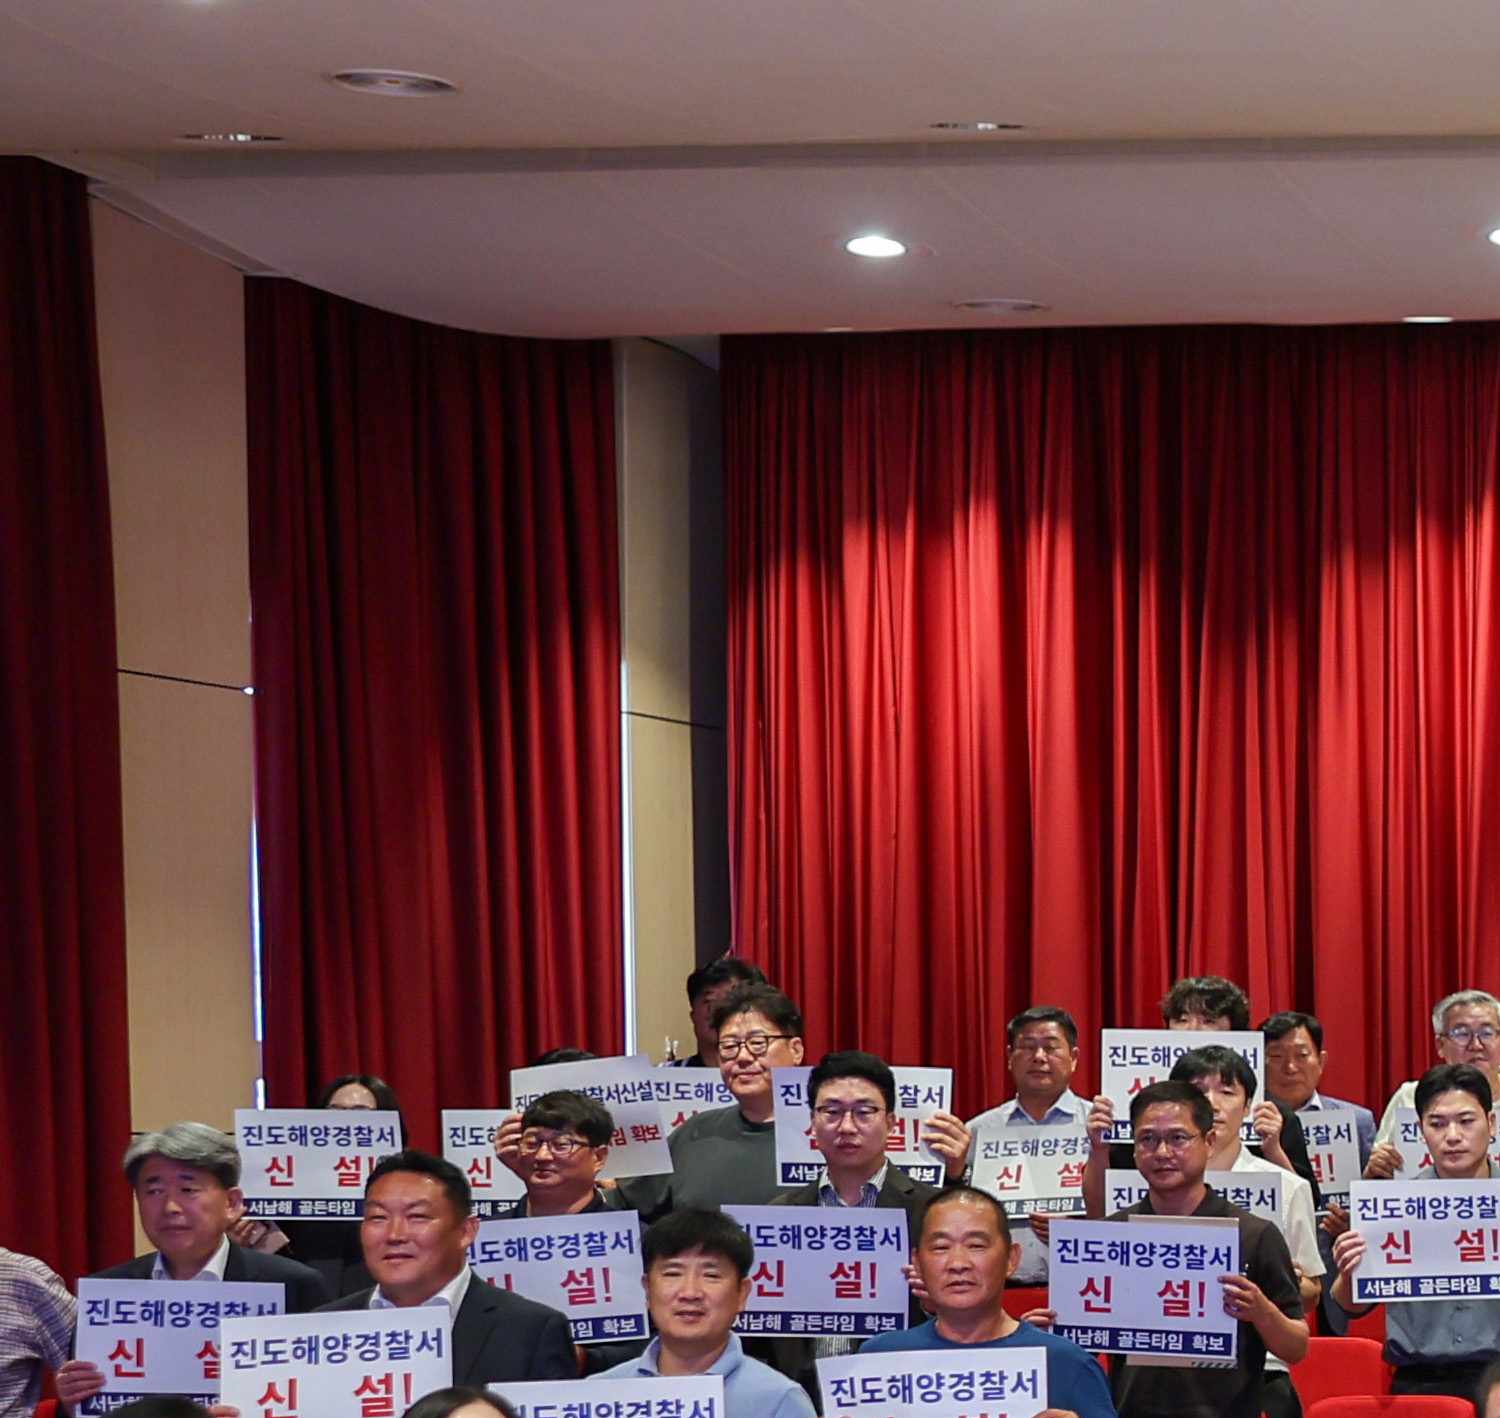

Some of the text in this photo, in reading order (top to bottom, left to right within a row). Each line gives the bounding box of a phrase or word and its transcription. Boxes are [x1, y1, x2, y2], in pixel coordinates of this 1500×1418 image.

[243, 1124, 396, 1148] 진도해양경찰서
[264, 1155, 294, 1187] 신
[248, 1200, 356, 1215] 서남해 골든타임
[1056, 1238, 1232, 1272] 진도해양경찰서
[1380, 1228, 1499, 1264] 신 설!
[751, 1259, 877, 1299] 신 설!
[1364, 1278, 1412, 1296] 서남해
[1418, 1276, 1481, 1295] 골든타임
[1078, 1275, 1206, 1318] 신 설!
[789, 1314, 895, 1333] 골든타임 확보
[230, 1327, 443, 1370] 진도해양경찰서
[1058, 1328, 1225, 1354] 서남해 골든타임 확보
[829, 1368, 1038, 1408] 진도해양경찰서
